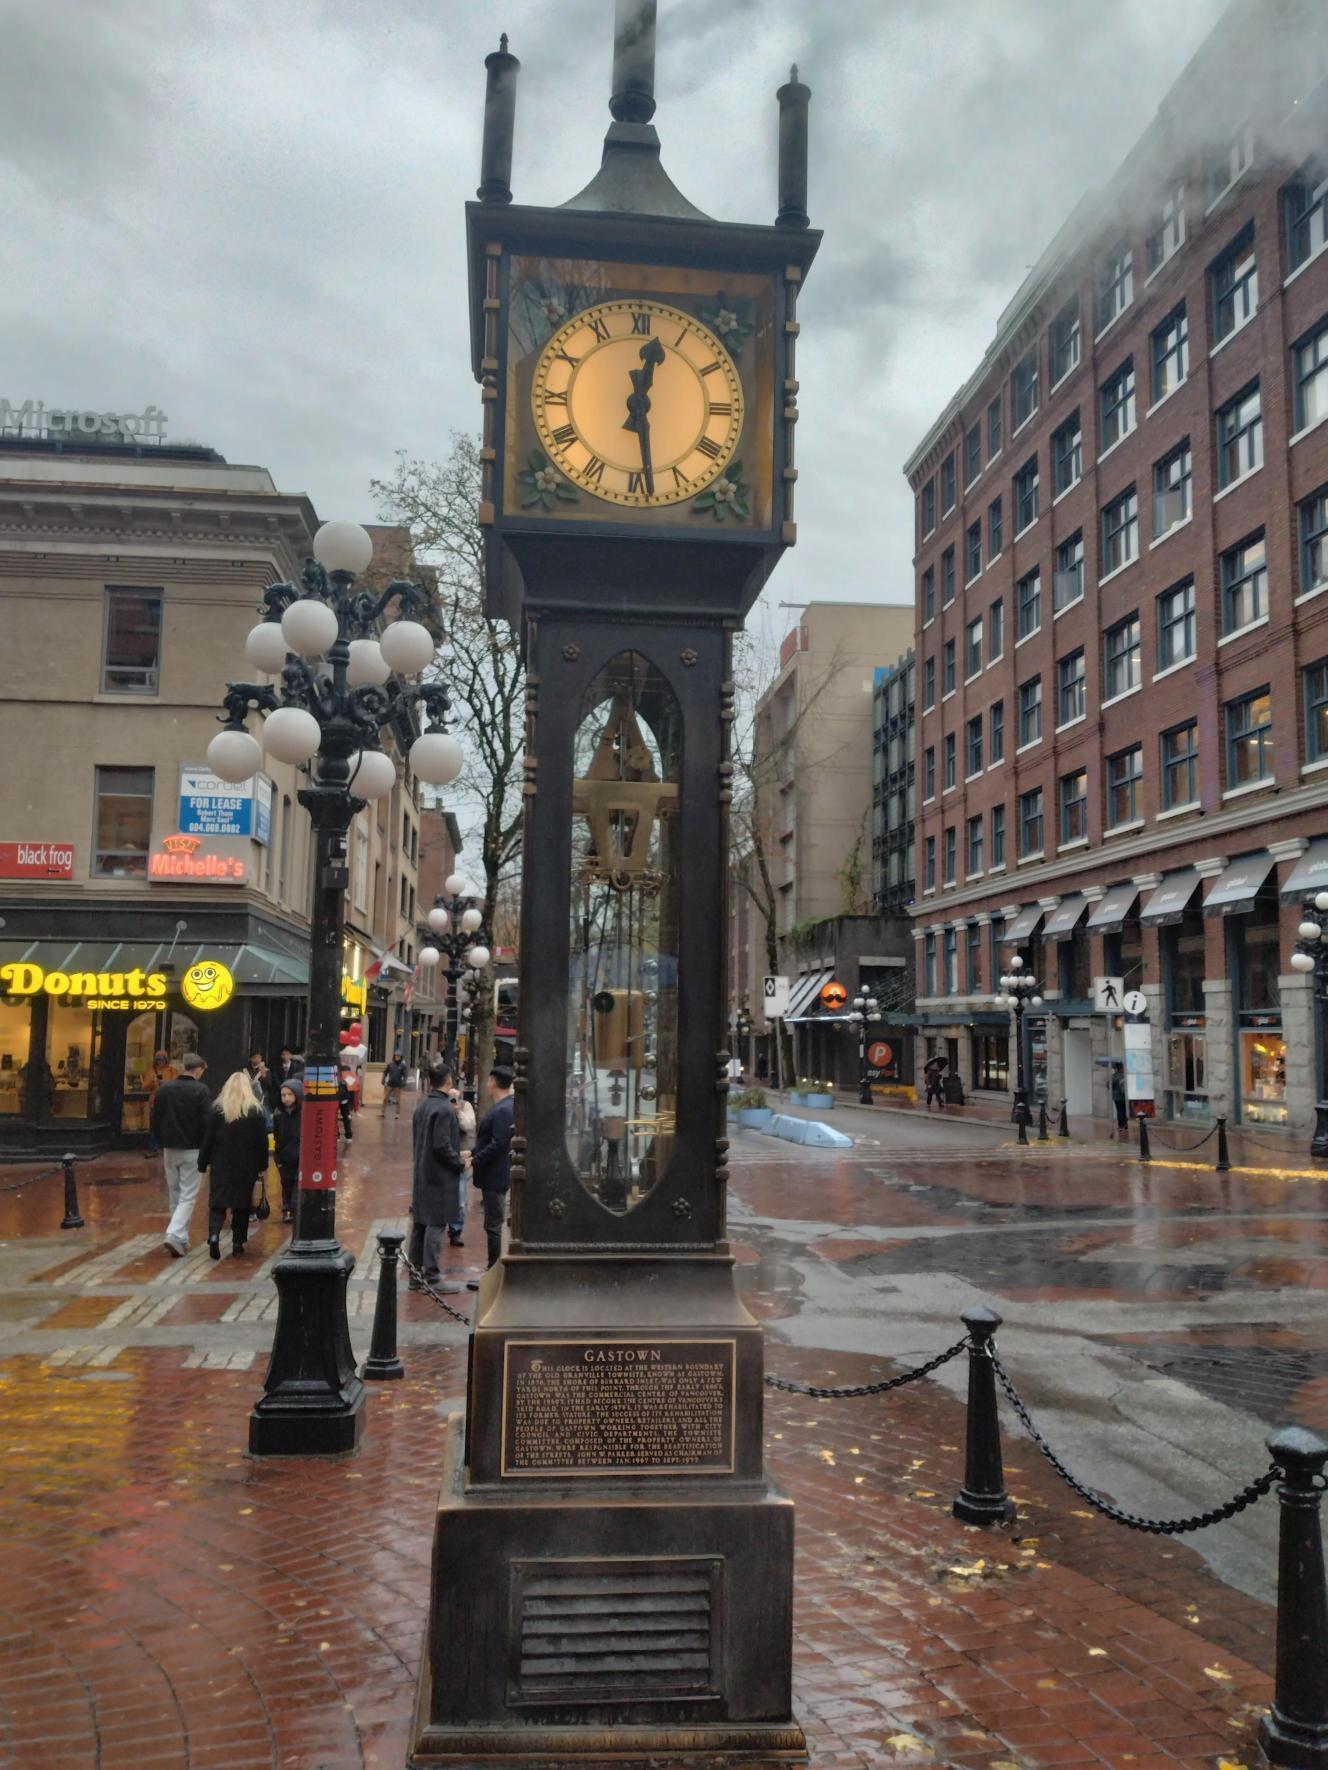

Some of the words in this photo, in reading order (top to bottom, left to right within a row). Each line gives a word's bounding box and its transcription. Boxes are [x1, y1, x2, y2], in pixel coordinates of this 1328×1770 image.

[588, 318, 611, 344] XI
[631, 312, 651, 336] XII
[555, 346, 581, 368] X
[698, 361, 722, 377] II
[544, 391, 568, 406] IX
[708, 402, 732, 416] III
[1, 398, 168, 438] Microsoft
[551, 424, 579, 452] VIII
[696, 436, 723, 460] IIII
[583, 455, 606, 484] VII
[671, 466, 690, 488] V
[190, 798, 210, 809] FOR
[212, 799, 243, 811] LEASE
[17, 844, 47, 865] black
[49, 845, 72, 870] frog
[152, 854, 244, 878] Michelle's
[1, 963, 167, 996] Donuts
[87, 1000, 129, 1010] SINCE
[133, 1000, 166, 1010] 1979
[874, 1046, 886, 1062] P
[313, 1109, 324, 1161] GASTOWN
[530, 1360, 554, 1372] THIS
[584, 1350, 662, 1362] GASTOWN
